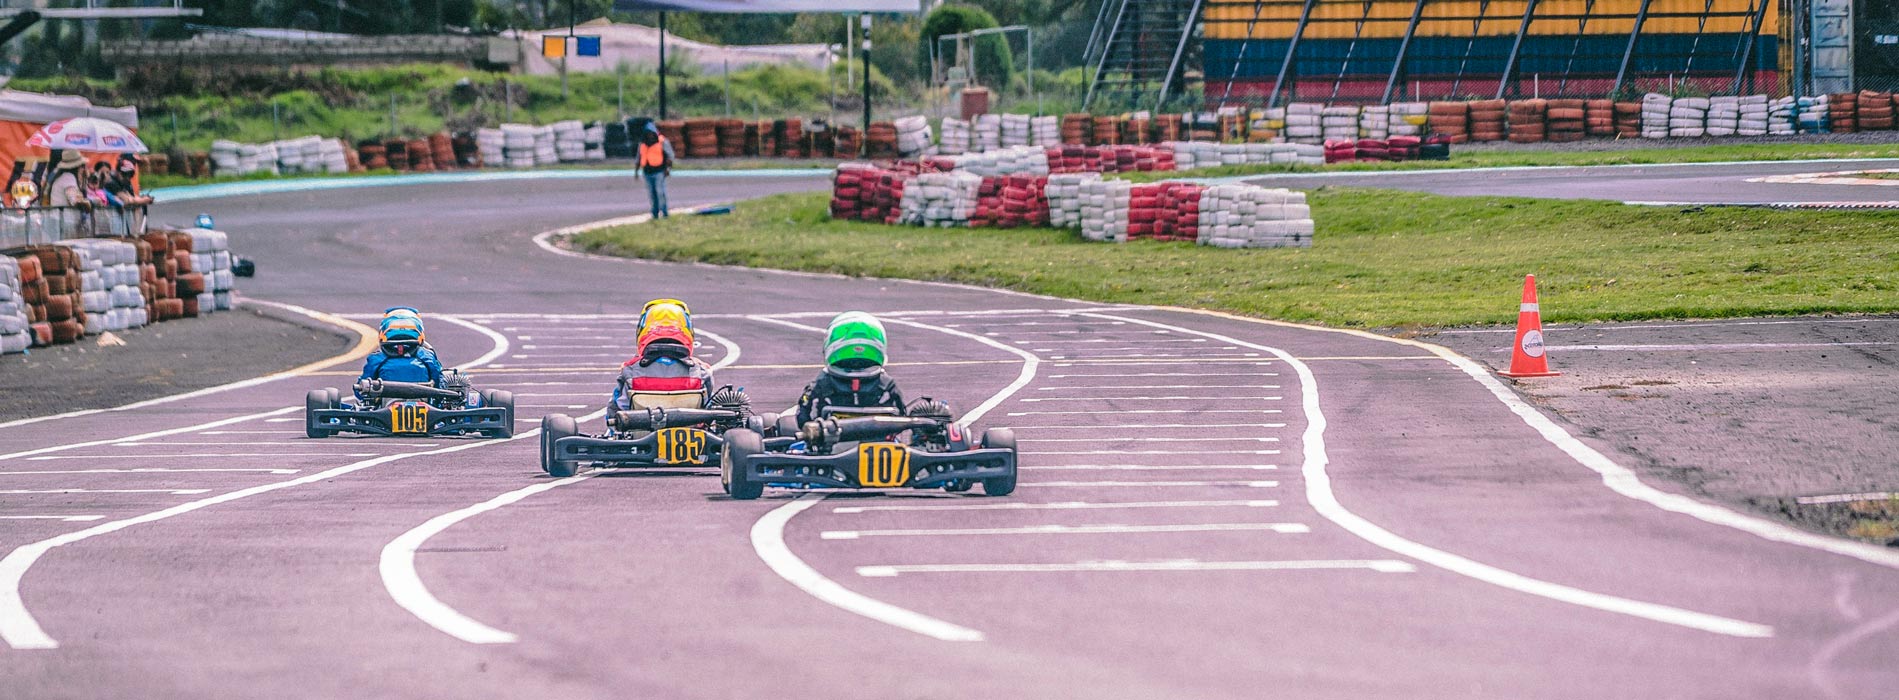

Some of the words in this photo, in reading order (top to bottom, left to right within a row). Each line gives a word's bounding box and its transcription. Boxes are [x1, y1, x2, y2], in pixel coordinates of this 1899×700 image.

[395, 404, 426, 432] 105
[661, 429, 704, 461] 185
[864, 446, 906, 483] 107
